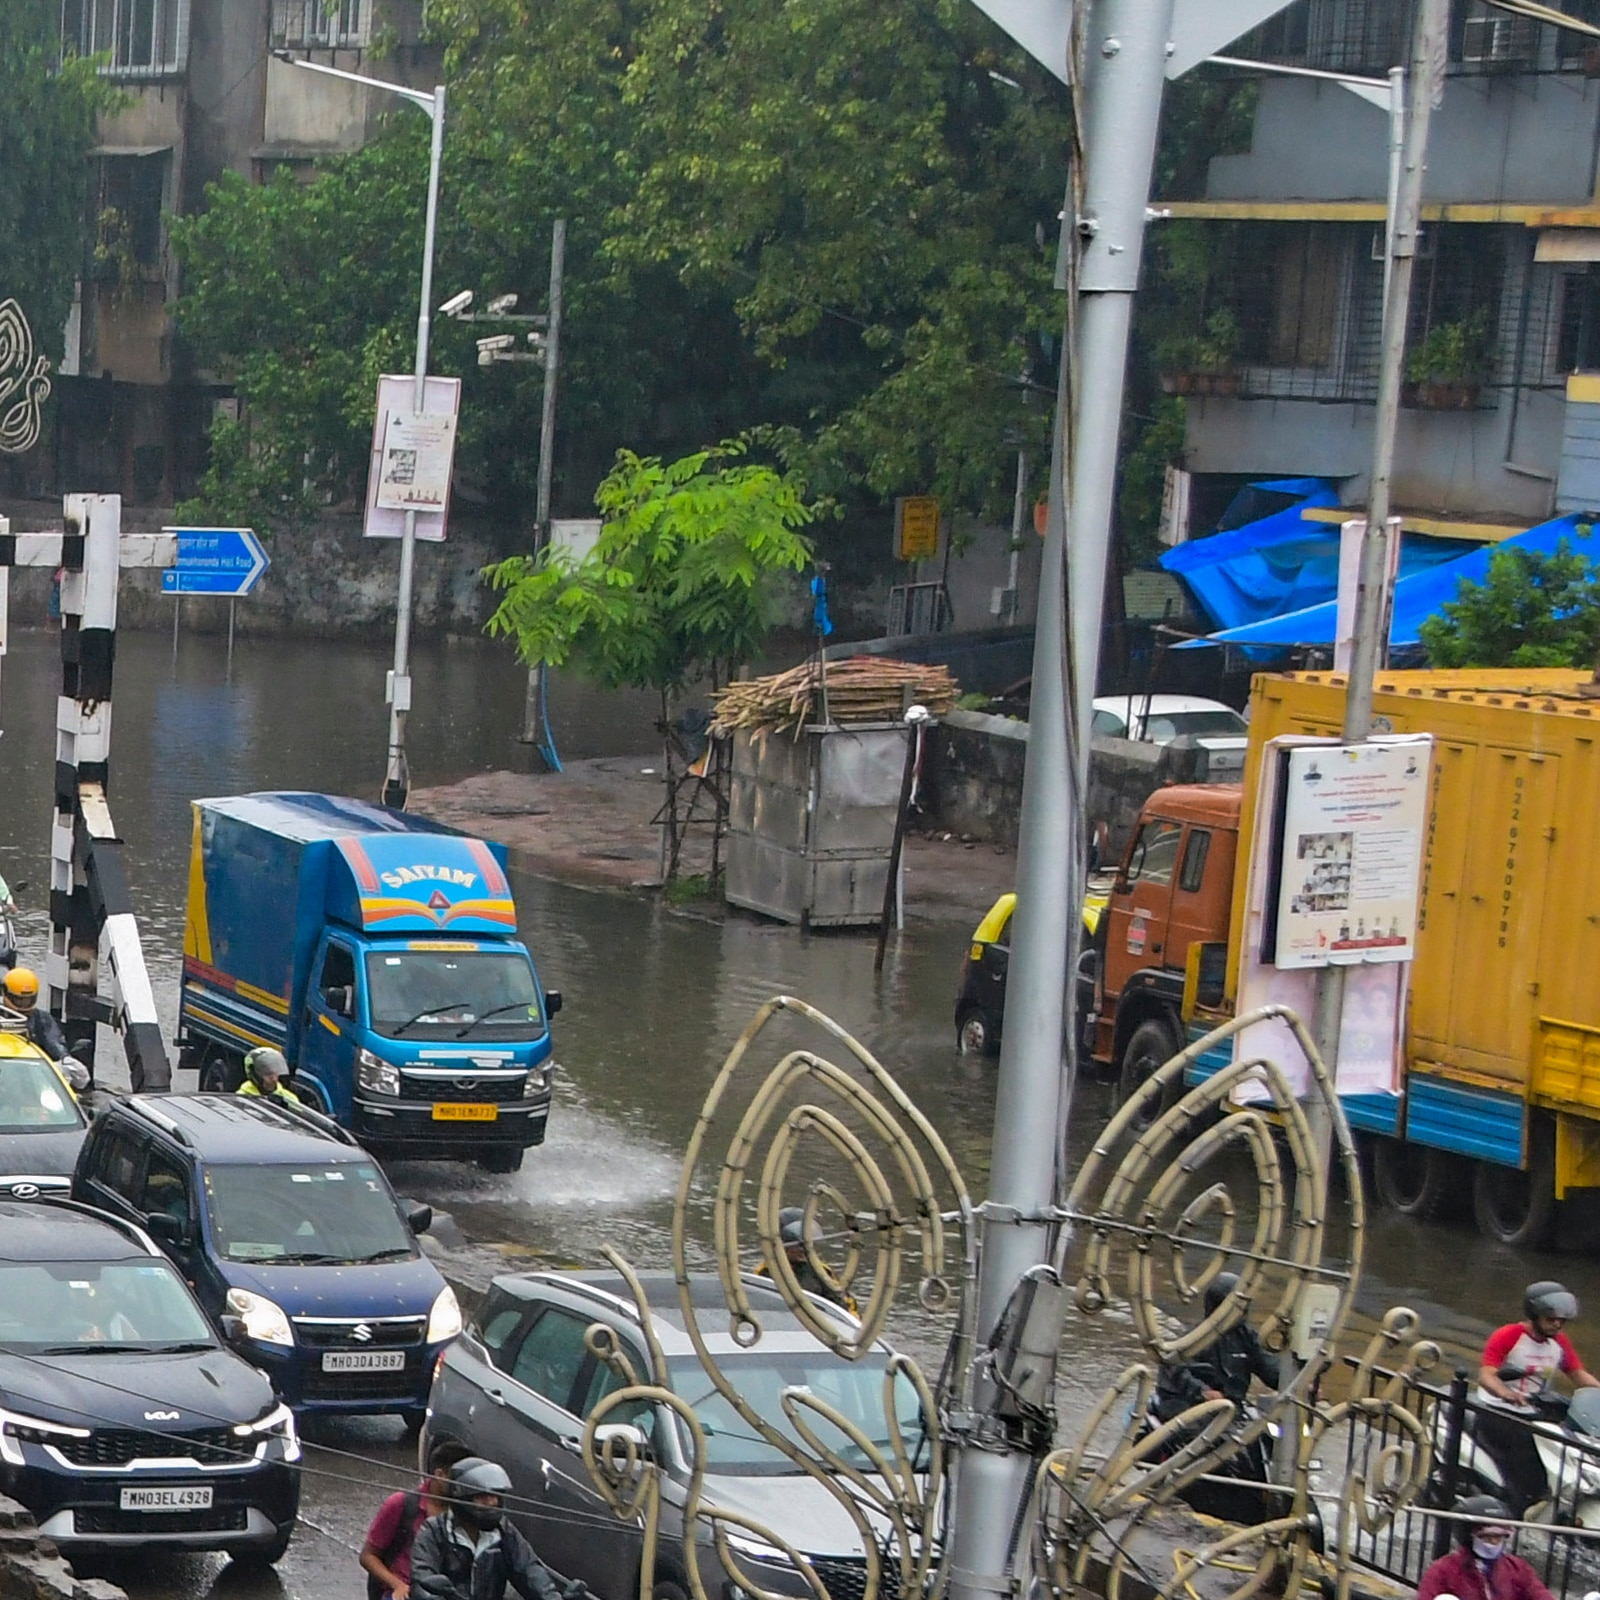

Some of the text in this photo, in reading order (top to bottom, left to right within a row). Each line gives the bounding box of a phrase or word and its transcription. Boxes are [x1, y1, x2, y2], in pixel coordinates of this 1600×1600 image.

[381, 865, 477, 888] SAIYAM
[331, 1354, 404, 1369] MH03DA3887
[129, 1490, 211, 1506] MH03EL4928
